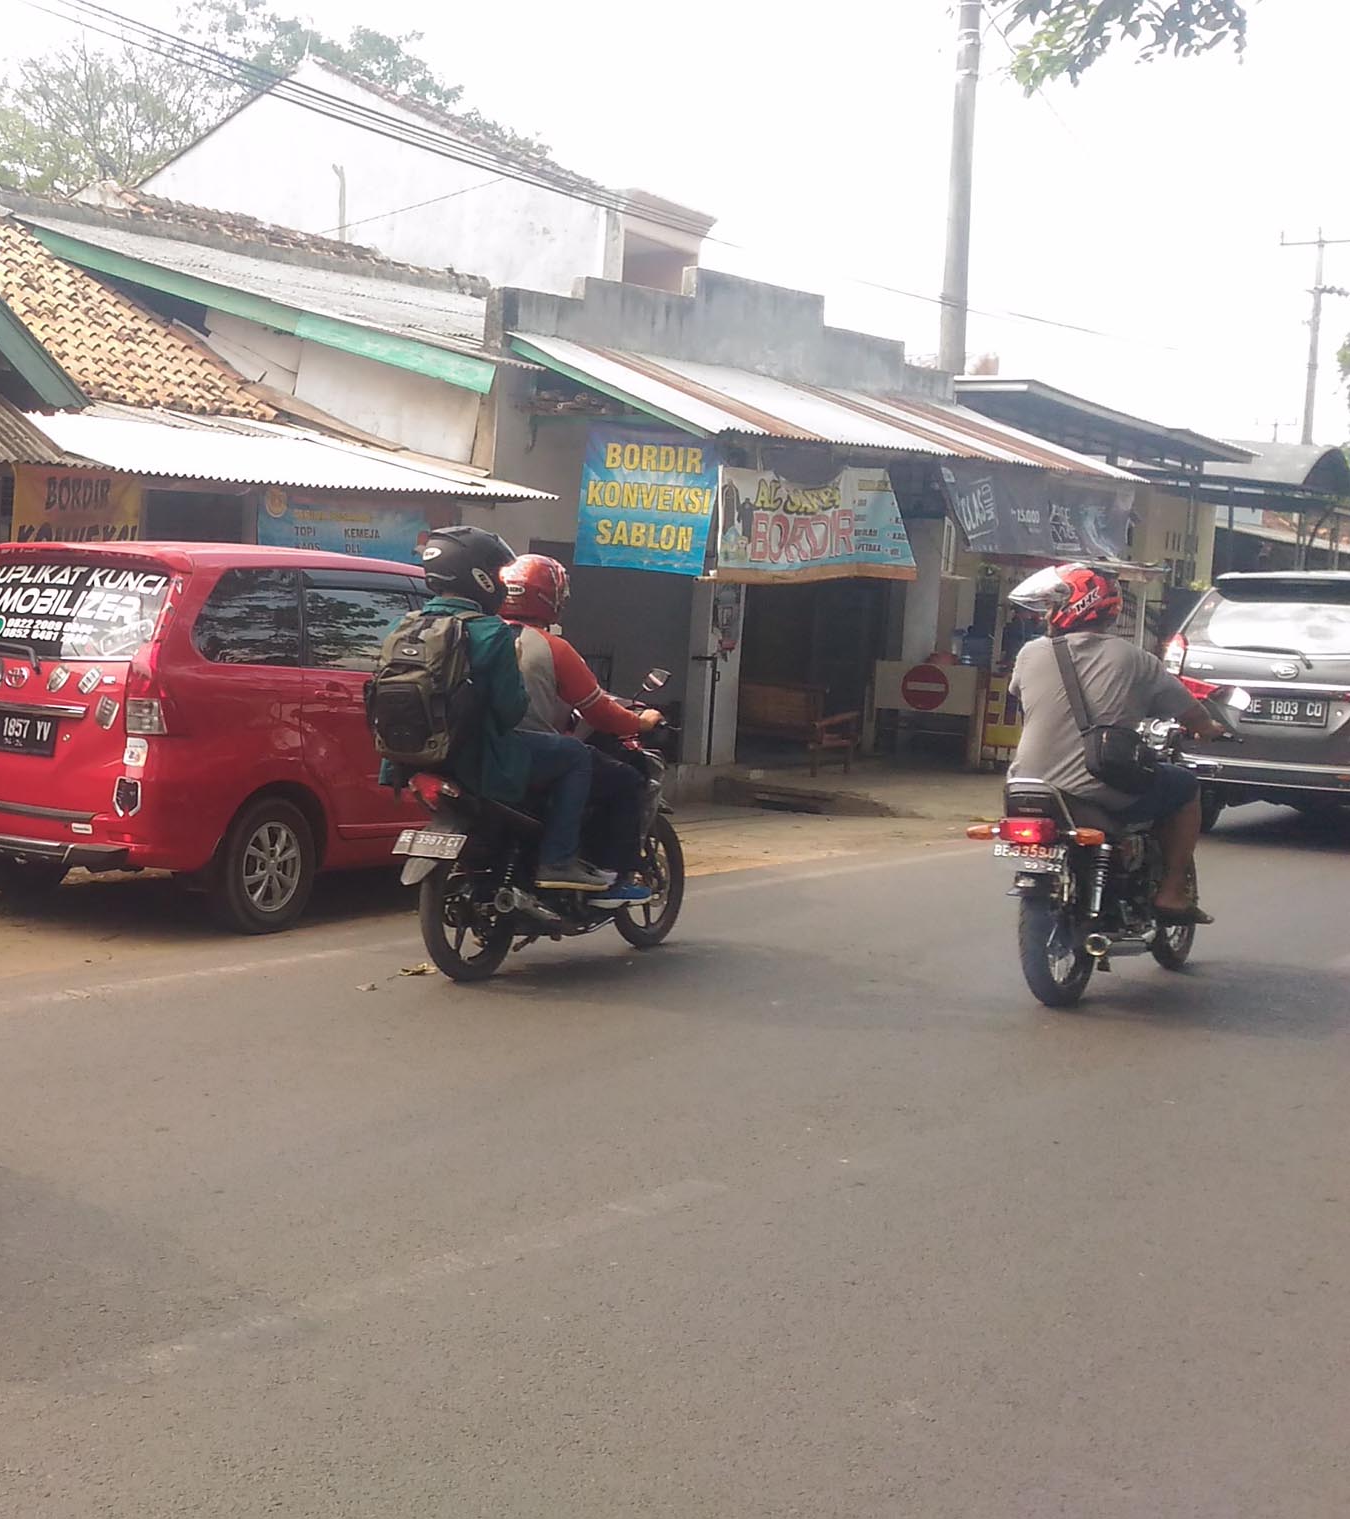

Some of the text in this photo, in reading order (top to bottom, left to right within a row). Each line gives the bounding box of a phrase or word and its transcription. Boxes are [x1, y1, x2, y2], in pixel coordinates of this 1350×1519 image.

[605, 442, 703, 474] BORDIR
[44, 475, 111, 511] BORDIR
[586, 480, 712, 515] KONVEKSI
[294, 526, 381, 539] TOPI KEMEJA
[595, 518, 693, 552] SABLON
[749, 508, 856, 565] BORDIR
[86, 568, 167, 596] KUNCI
[1269, 701, 1298, 715] 1803
[3, 717, 31, 738] 1857
[36, 720, 51, 741] YV
[993, 844, 1009, 856] BE
